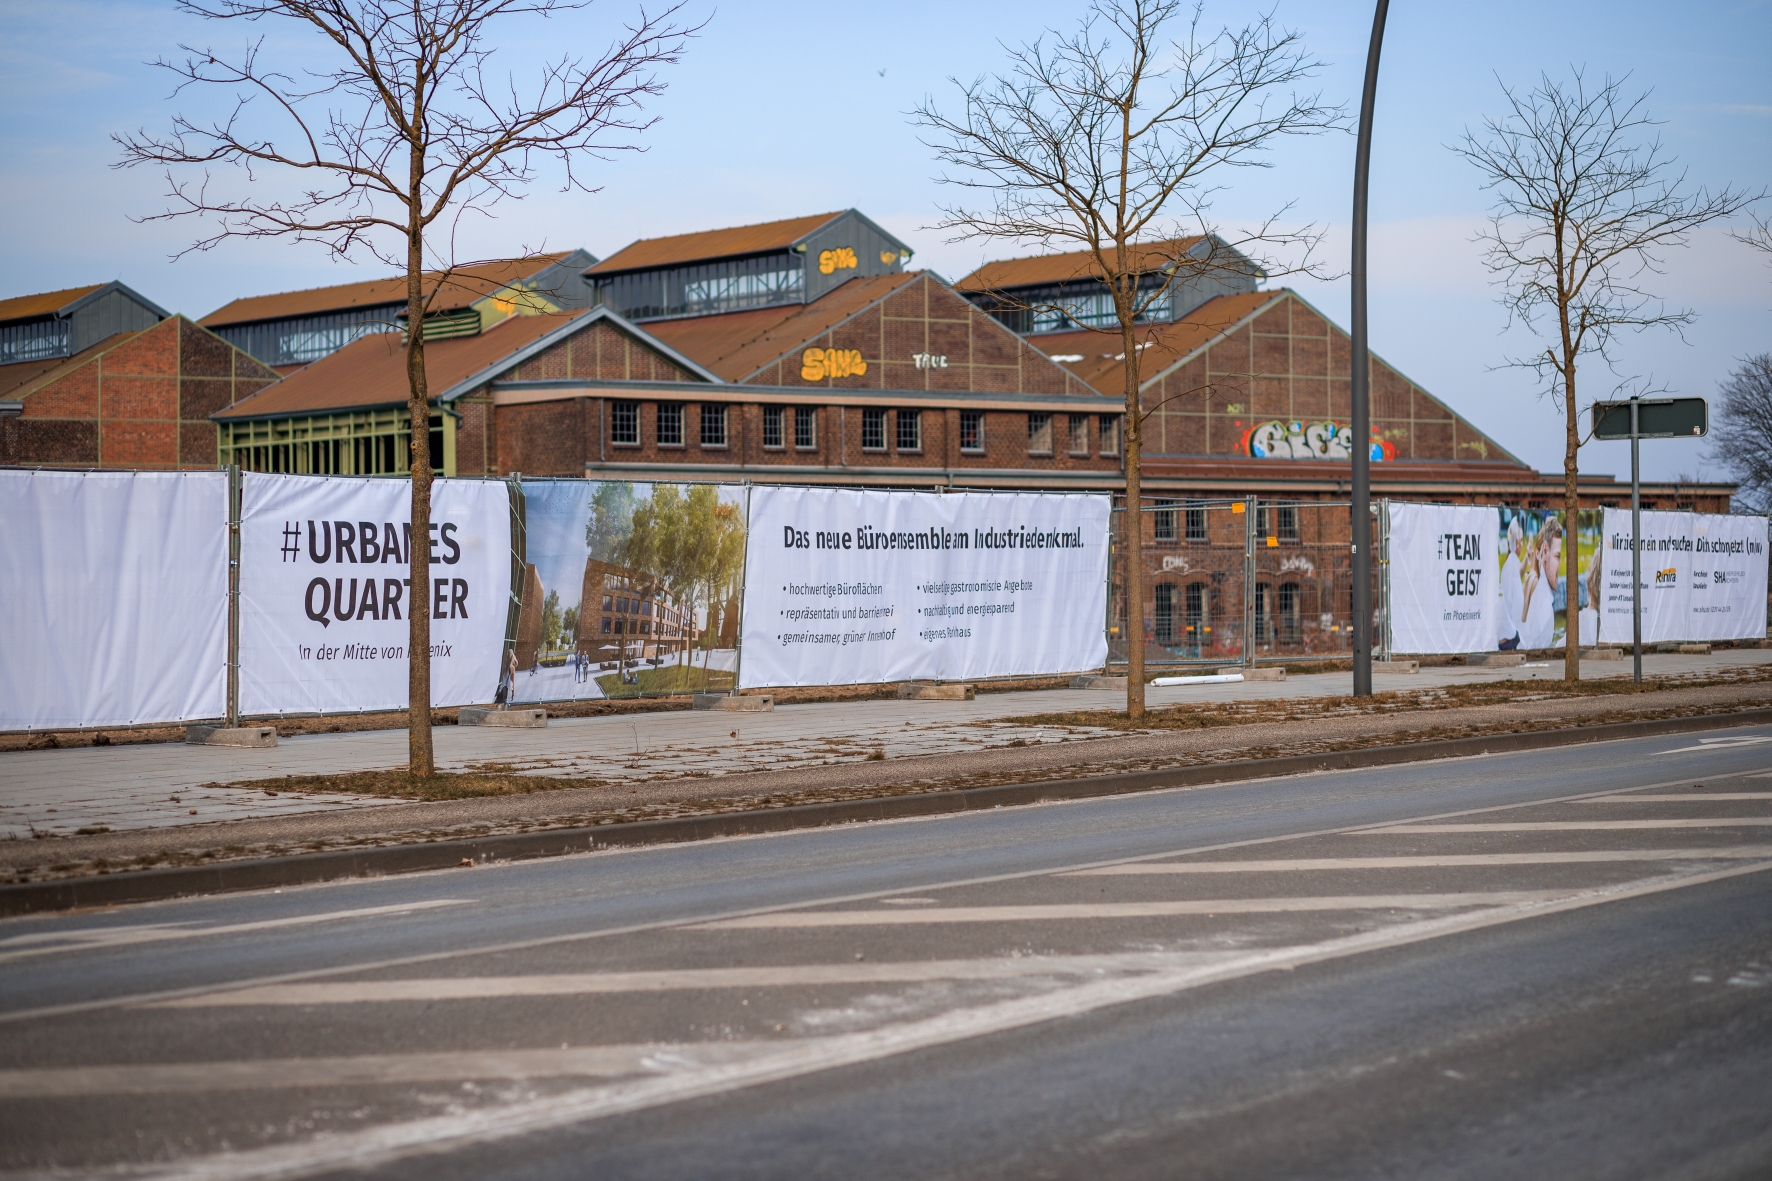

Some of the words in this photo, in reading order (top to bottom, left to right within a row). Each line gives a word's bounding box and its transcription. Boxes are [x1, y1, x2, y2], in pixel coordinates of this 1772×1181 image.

[784, 525, 810, 549] Das
[816, 530, 852, 550] neue
[857, 525, 950, 550] Büroensemble
[953, 531, 969, 549] am
[974, 525, 1084, 549] Industriedenkmal.
[789, 582, 837, 598] hochwertige
[837, 582, 883, 596] Büroflächen
[1446, 568, 1481, 596] GEIST
[304, 577, 469, 629] QUARER
[786, 606, 840, 622] repräsentativ
[842, 607, 857, 619] und
[842, 630, 866, 646] grüner
[316, 643, 340, 660] der
[343, 643, 378, 660] Mitte
[381, 647, 403, 659] von
